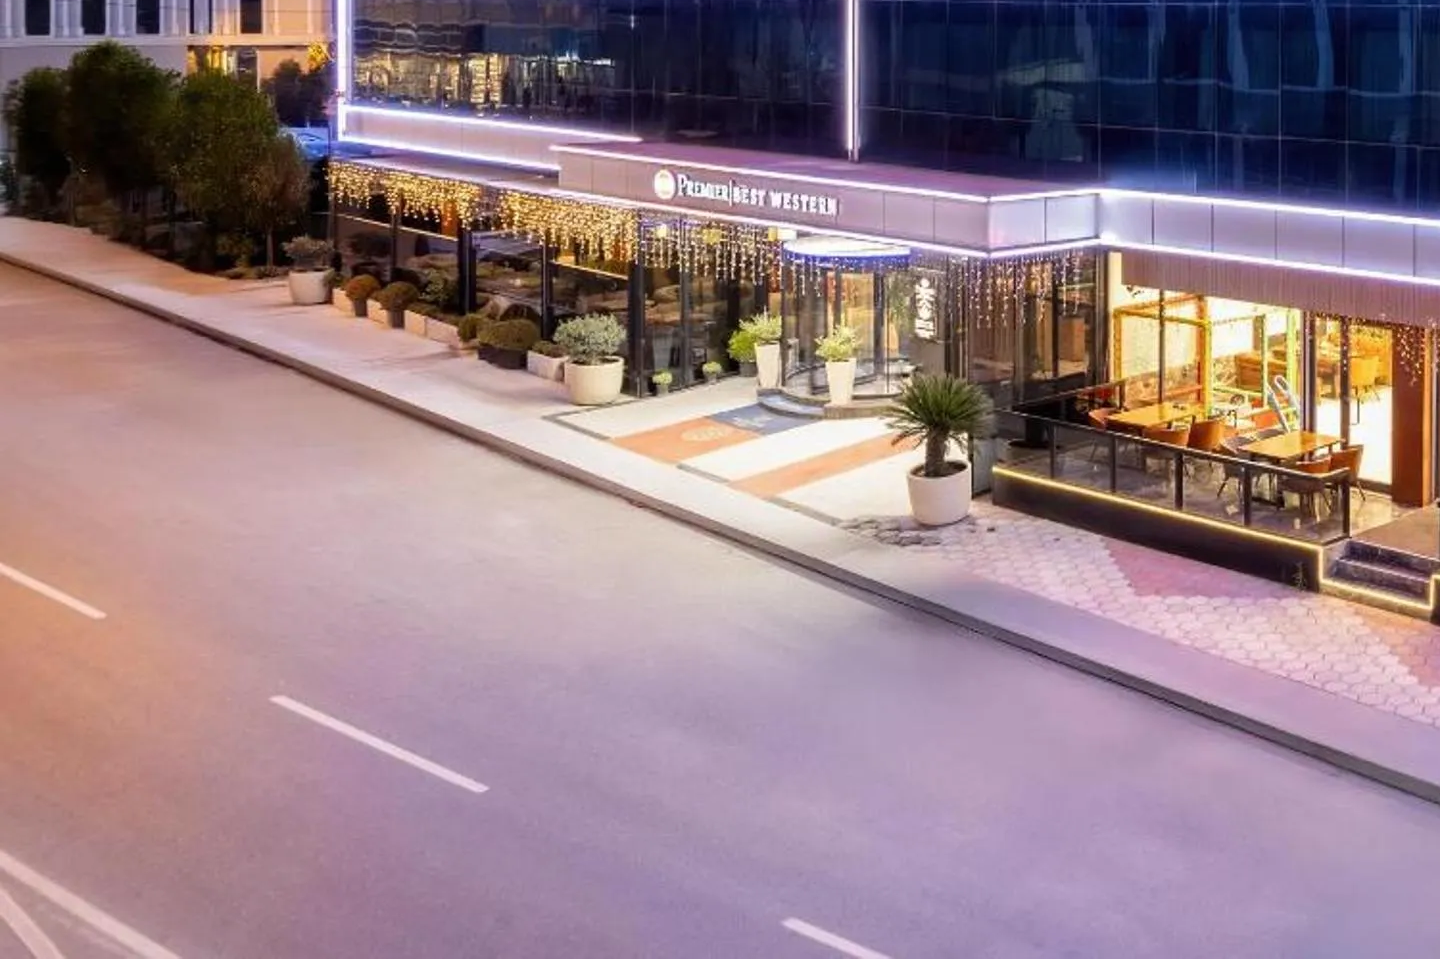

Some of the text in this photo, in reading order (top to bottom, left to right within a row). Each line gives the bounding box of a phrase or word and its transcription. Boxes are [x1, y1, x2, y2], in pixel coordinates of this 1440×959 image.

[677, 173, 730, 202] PREMIER
[733, 186, 767, 205] BEST
[770, 191, 838, 216] WESTERN
